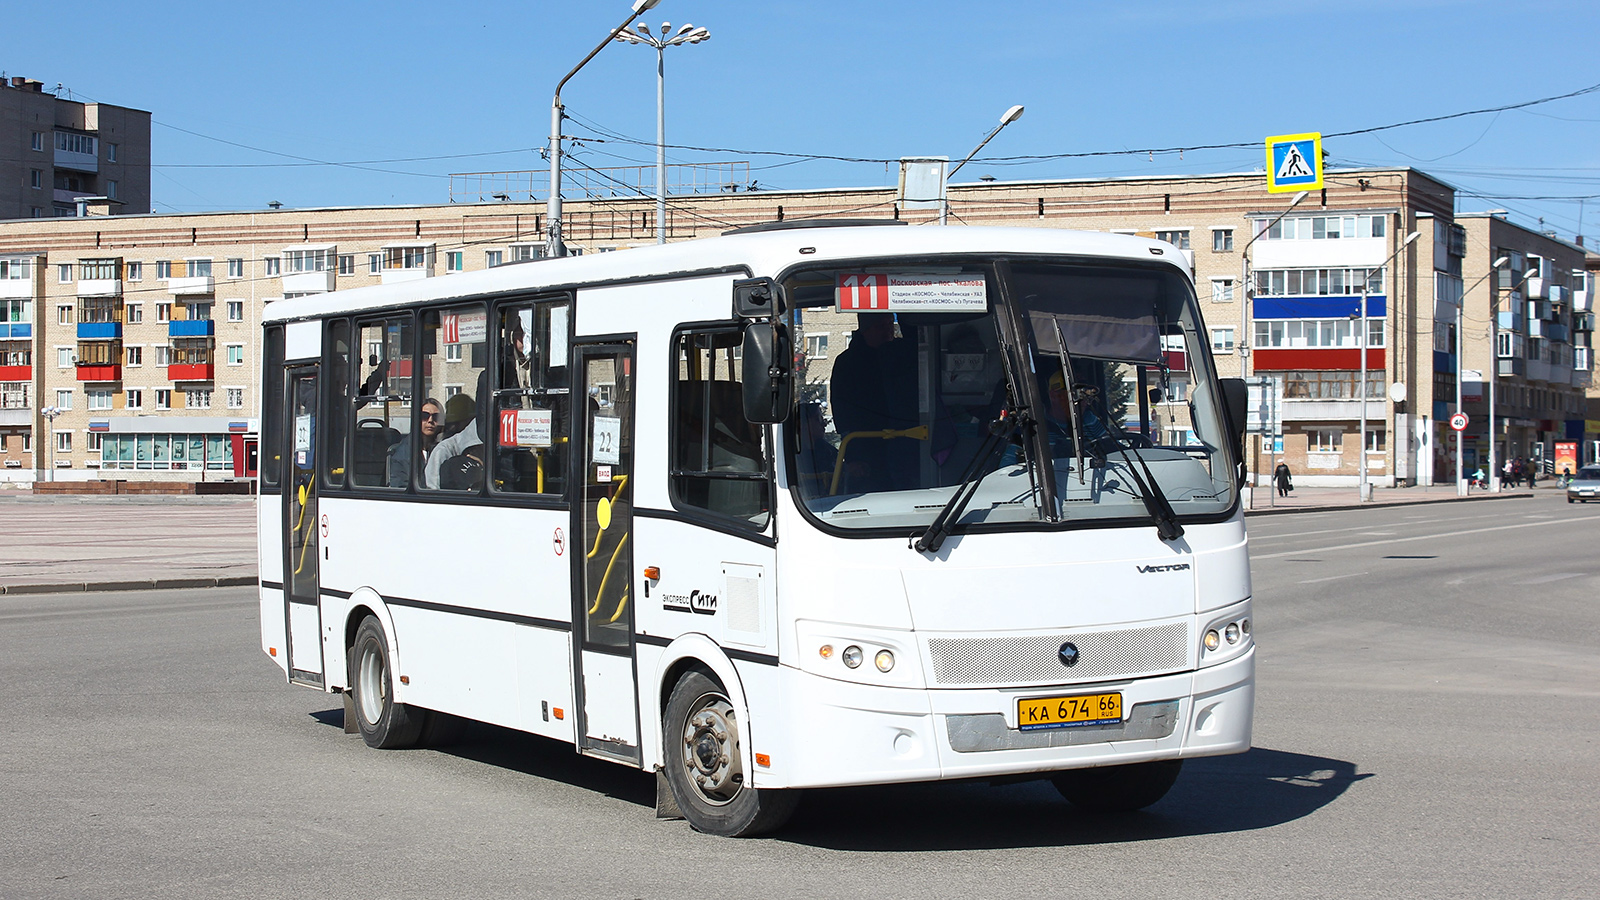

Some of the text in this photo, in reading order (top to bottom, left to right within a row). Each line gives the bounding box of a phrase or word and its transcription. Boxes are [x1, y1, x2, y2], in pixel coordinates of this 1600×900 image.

[844, 275, 877, 308] 11
[954, 279, 984, 287] Чкалова
[445, 315, 456, 342] 11
[502, 413, 515, 443] 11
[1454, 419, 1464, 427] 40
[599, 431, 612, 453] 22
[662, 594, 689, 605] ЭКСПРЕСС
[1028, 696, 1115, 721] КА 674 66
